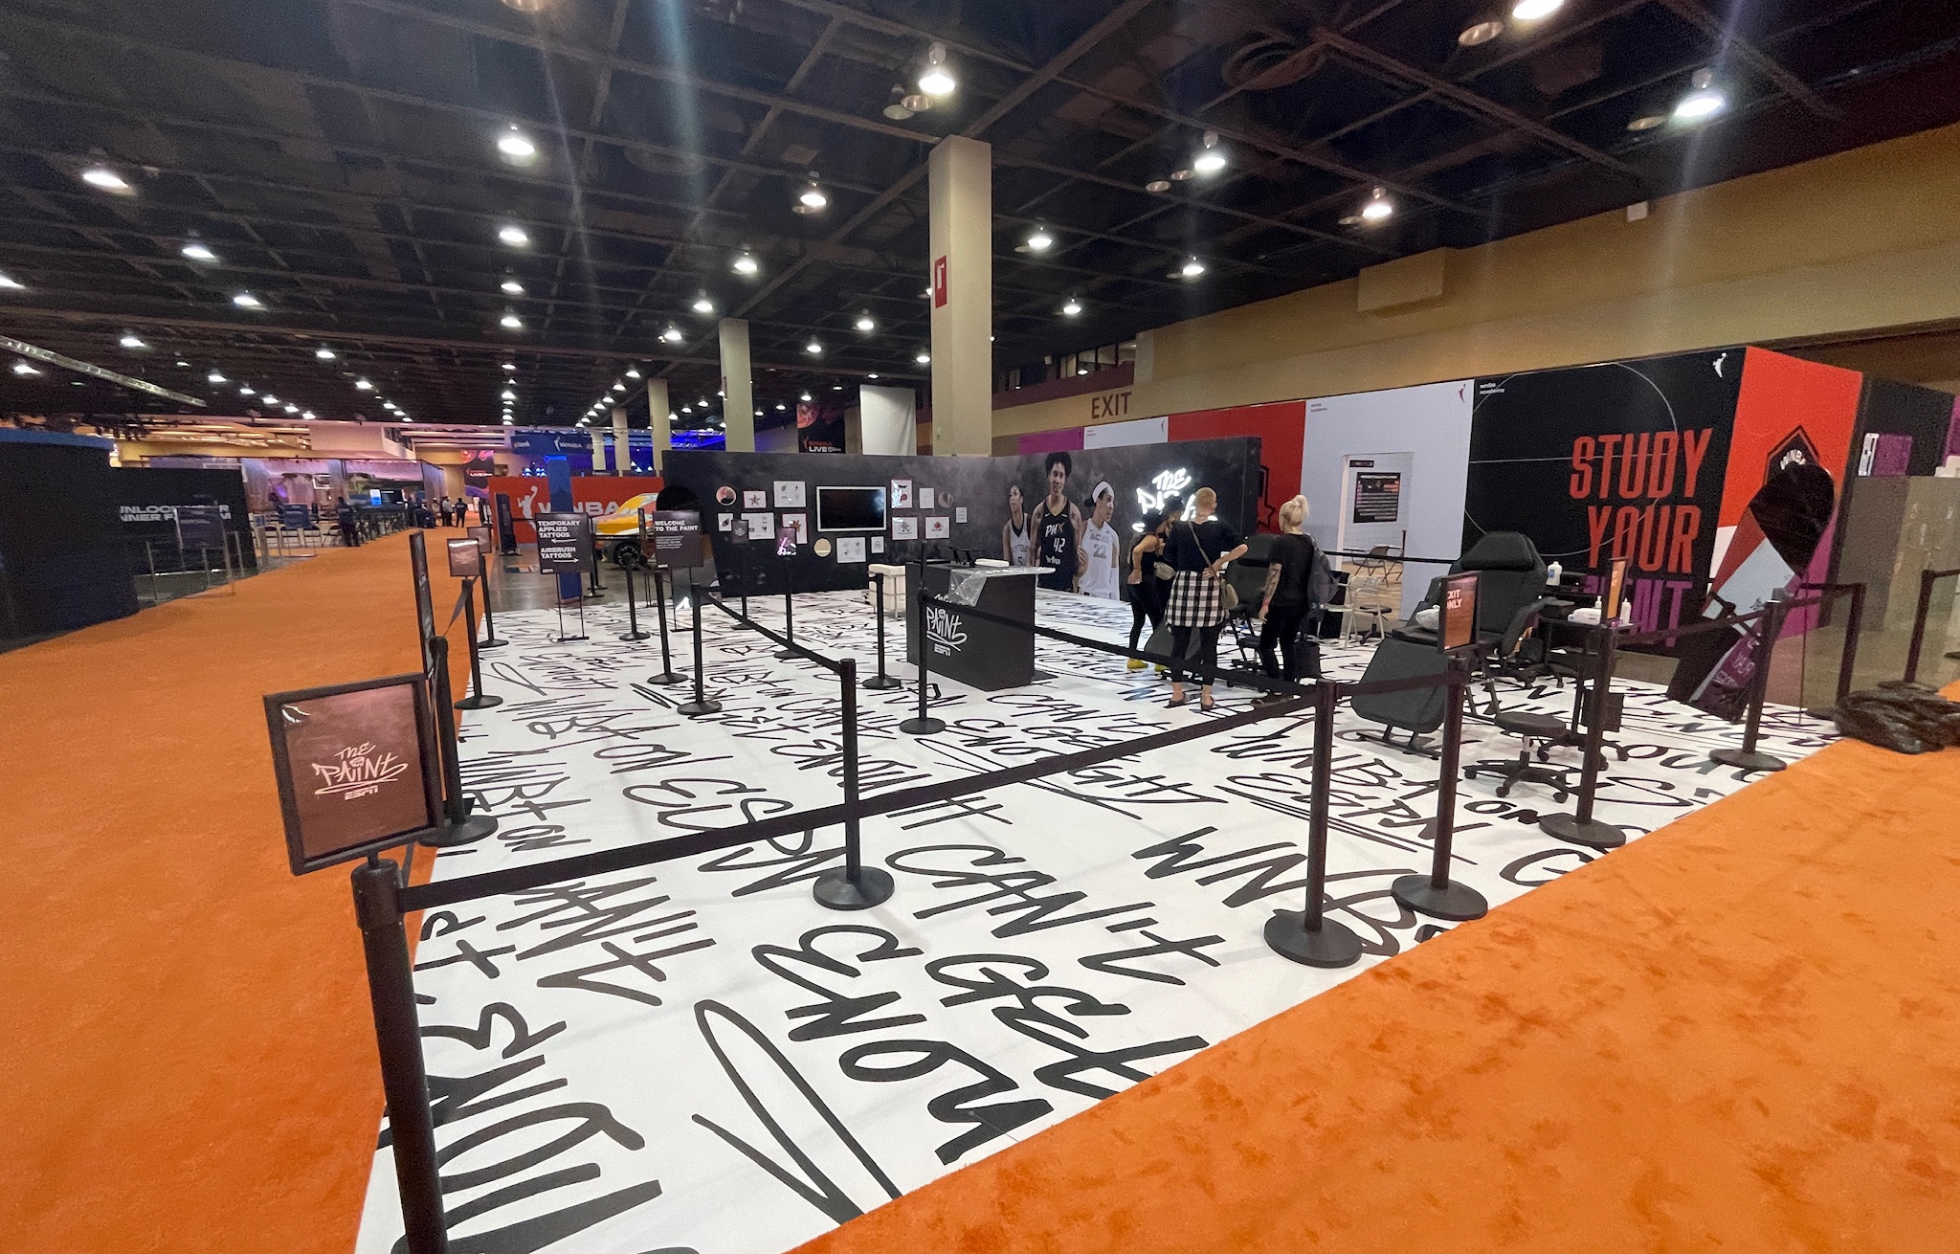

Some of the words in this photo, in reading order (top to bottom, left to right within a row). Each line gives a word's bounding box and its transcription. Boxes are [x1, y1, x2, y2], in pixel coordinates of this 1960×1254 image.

[1091, 392, 1132, 419] EXIT
[1569, 427, 1712, 499] STUDY
[1053, 538, 1066, 552] 42
[1587, 505, 1701, 574] YOUR
[1093, 543, 1107, 559] 22
[1447, 589, 1461, 599] XIT
[1446, 599, 1462, 609] NLY
[344, 785, 379, 800] ESPN
[884, 840, 1229, 987] CAN'T
